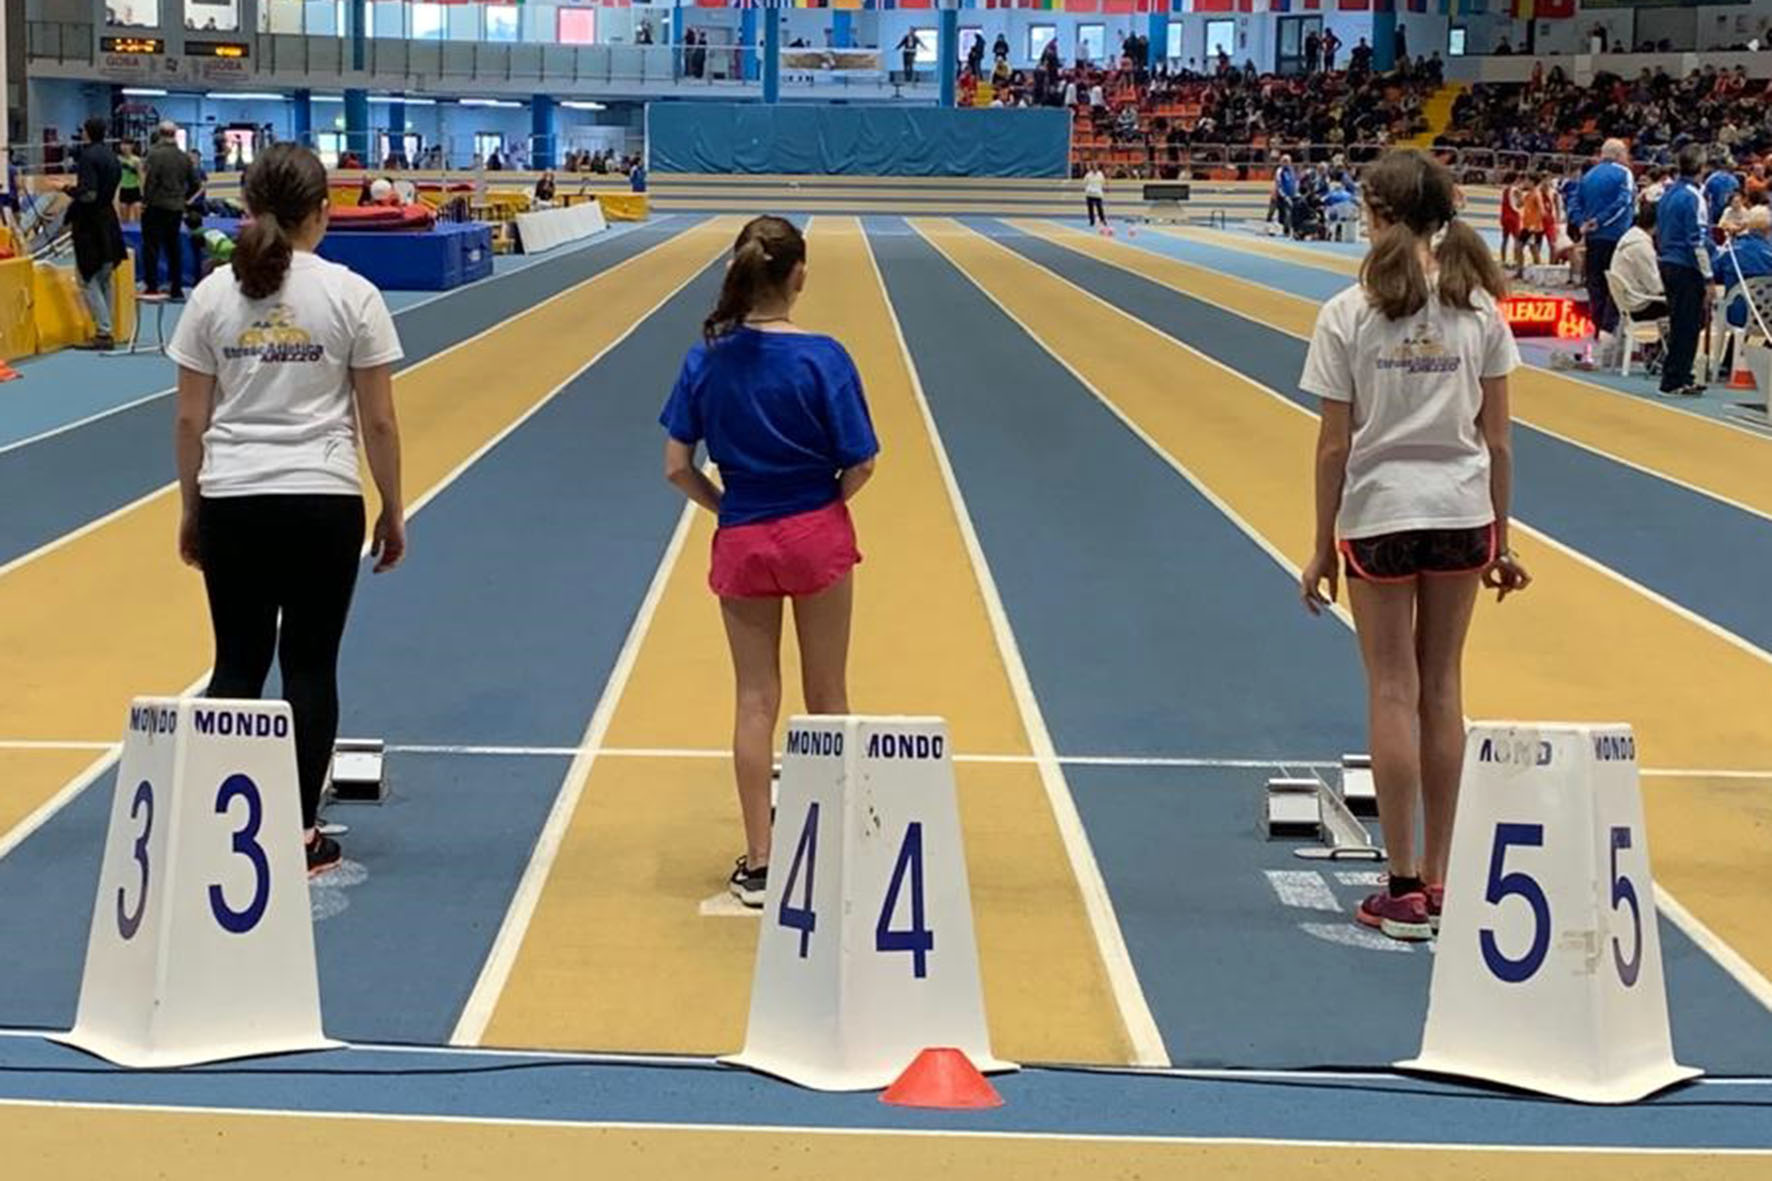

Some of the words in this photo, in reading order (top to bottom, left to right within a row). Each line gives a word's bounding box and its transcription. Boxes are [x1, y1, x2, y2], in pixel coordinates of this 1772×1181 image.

[129, 708, 177, 734] MONDO
[194, 710, 288, 738] MONDO
[787, 730, 844, 756] MONDO
[1594, 736, 1636, 761] MONDO
[117, 780, 154, 940] 3
[208, 773, 270, 934] 3
[779, 802, 820, 958] 4
[876, 822, 934, 979] 4
[1479, 822, 1551, 983] 5
[1610, 826, 1642, 987] 5
